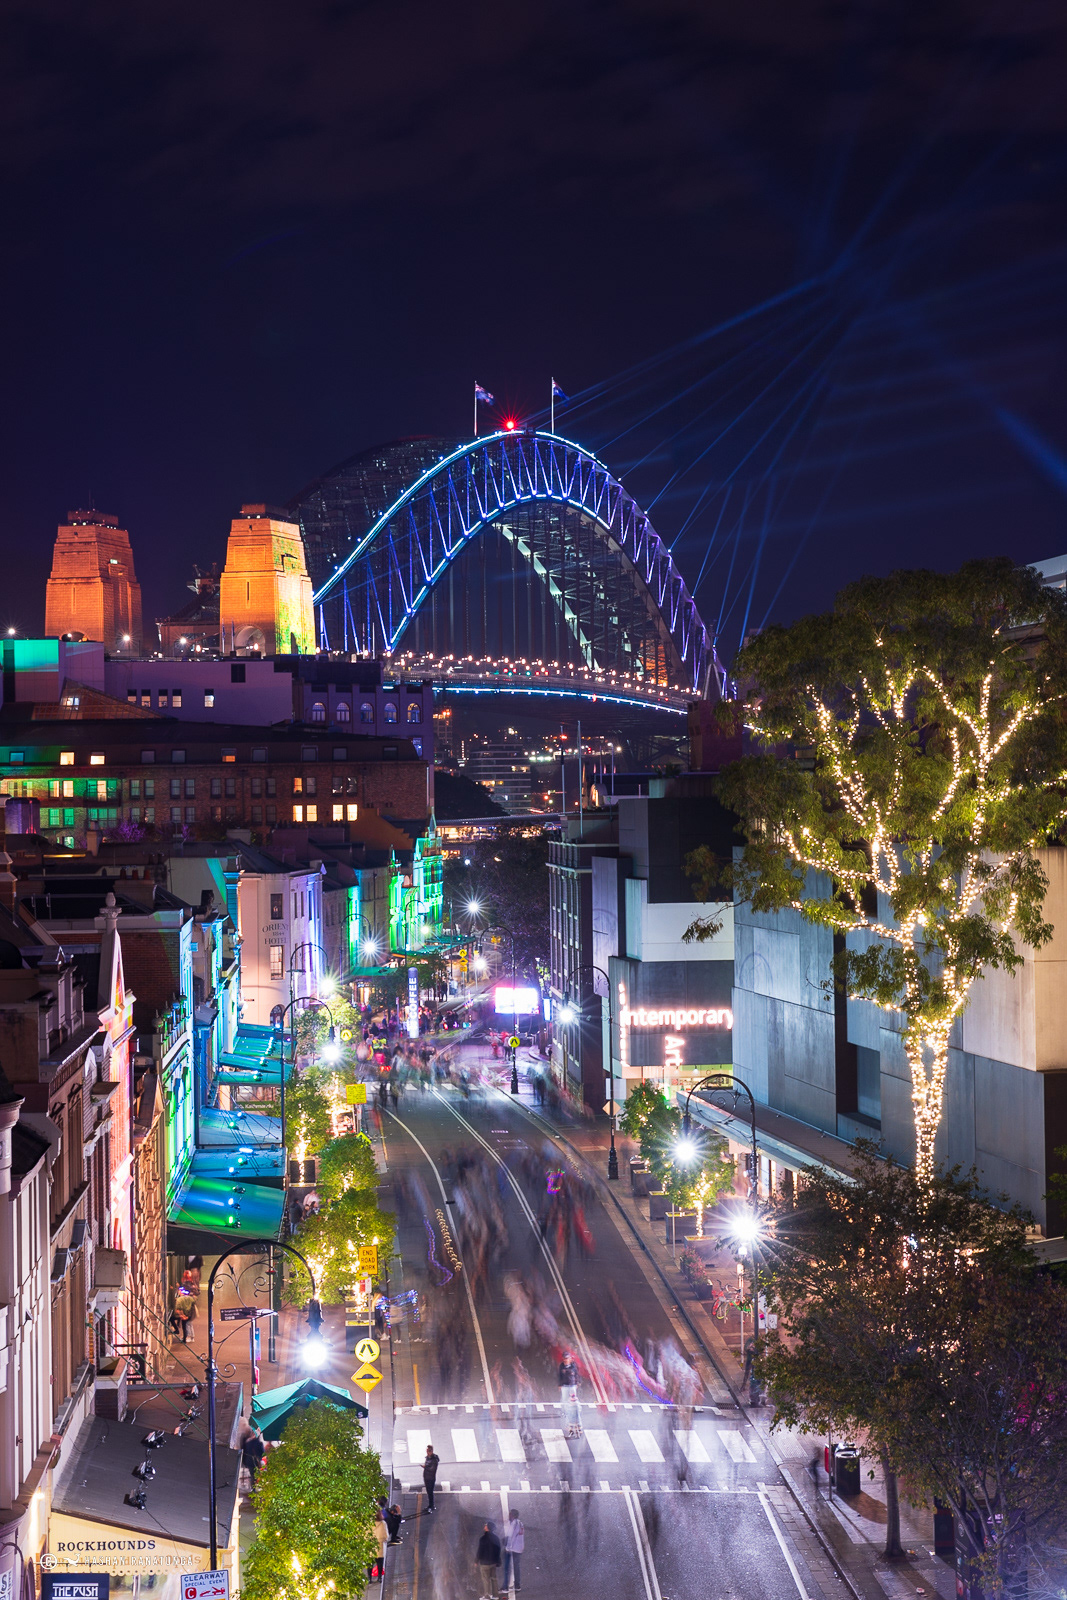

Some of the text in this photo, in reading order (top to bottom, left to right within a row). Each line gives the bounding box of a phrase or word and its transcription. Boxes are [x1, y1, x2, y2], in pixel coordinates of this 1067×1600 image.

[409, 977, 418, 1019] COFFEE
[664, 1035, 685, 1067] Art
[57, 1540, 156, 1551] ROCKHOUNDS
[184, 1572, 225, 1582] CLEARWAY
[53, 1587, 99, 1597] THE PUSH
